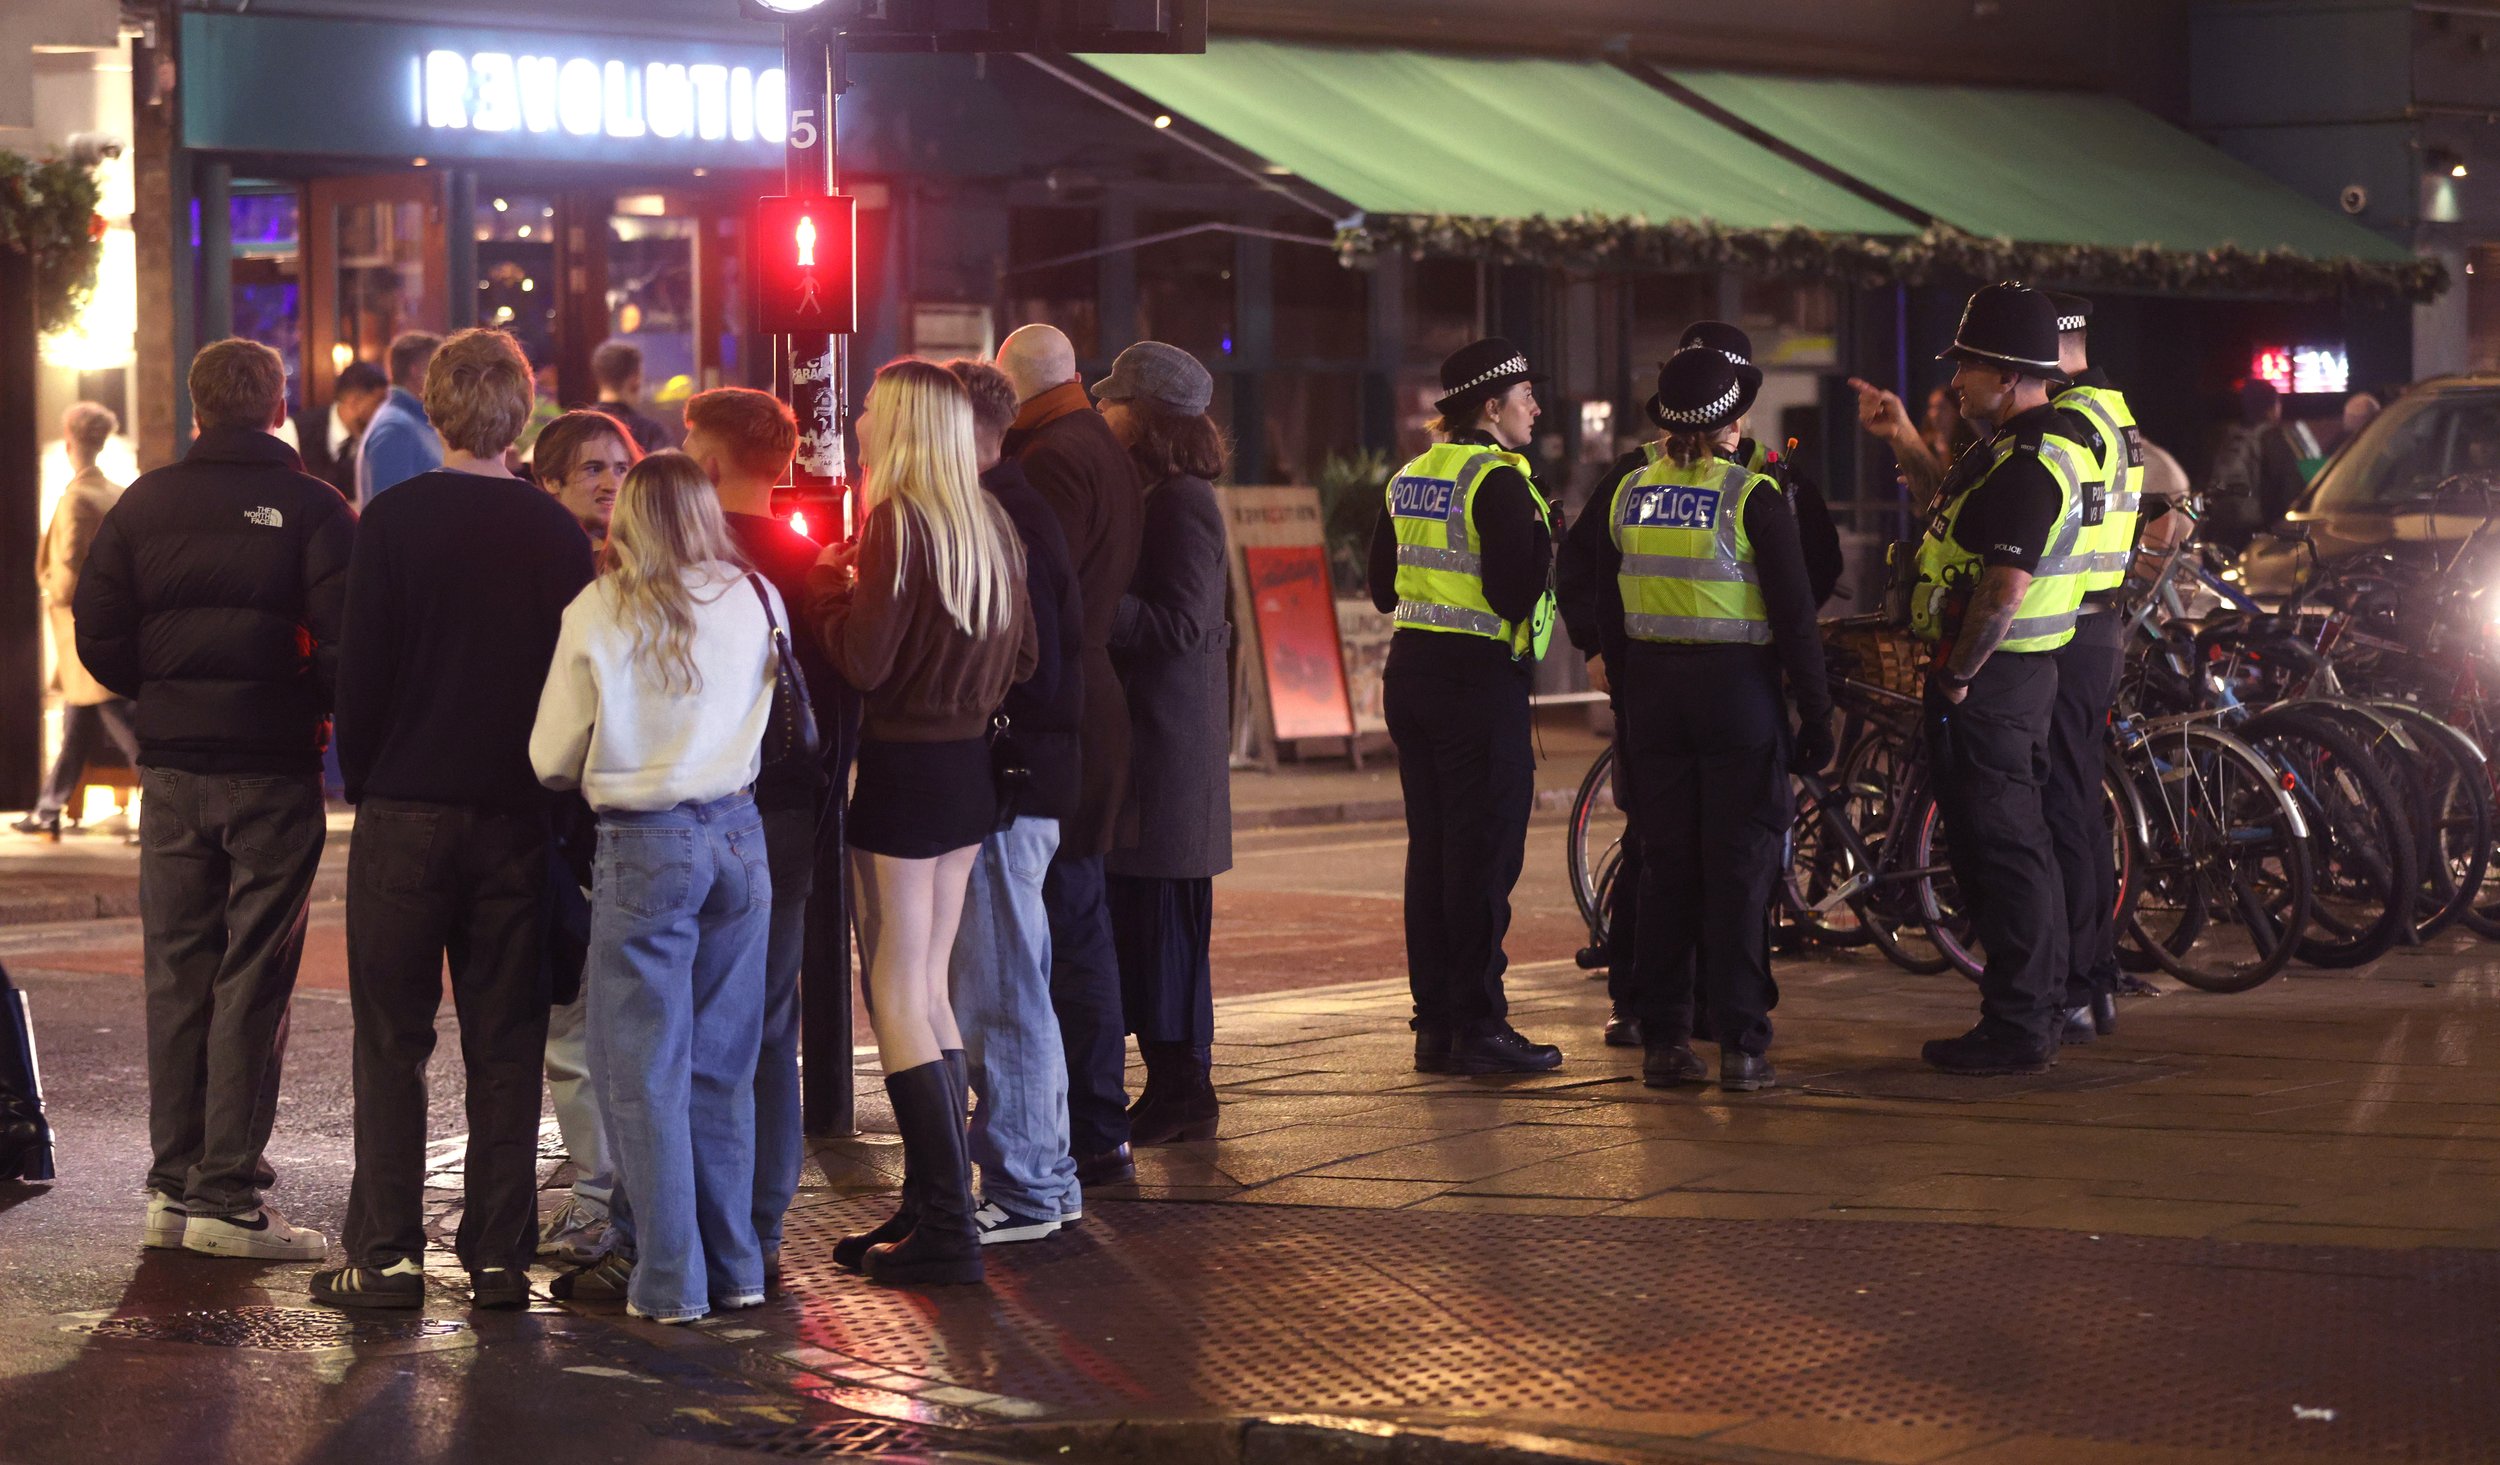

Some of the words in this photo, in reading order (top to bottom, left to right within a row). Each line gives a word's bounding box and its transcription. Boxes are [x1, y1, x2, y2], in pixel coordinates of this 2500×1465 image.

[790, 110, 817, 149] 5
[1395, 483, 1450, 512] POLICE
[1626, 492, 1714, 523] POLICE
[244, 511, 270, 520] NORTH
[251, 518, 271, 526] FACE
[1994, 544, 2022, 555] POLICE
